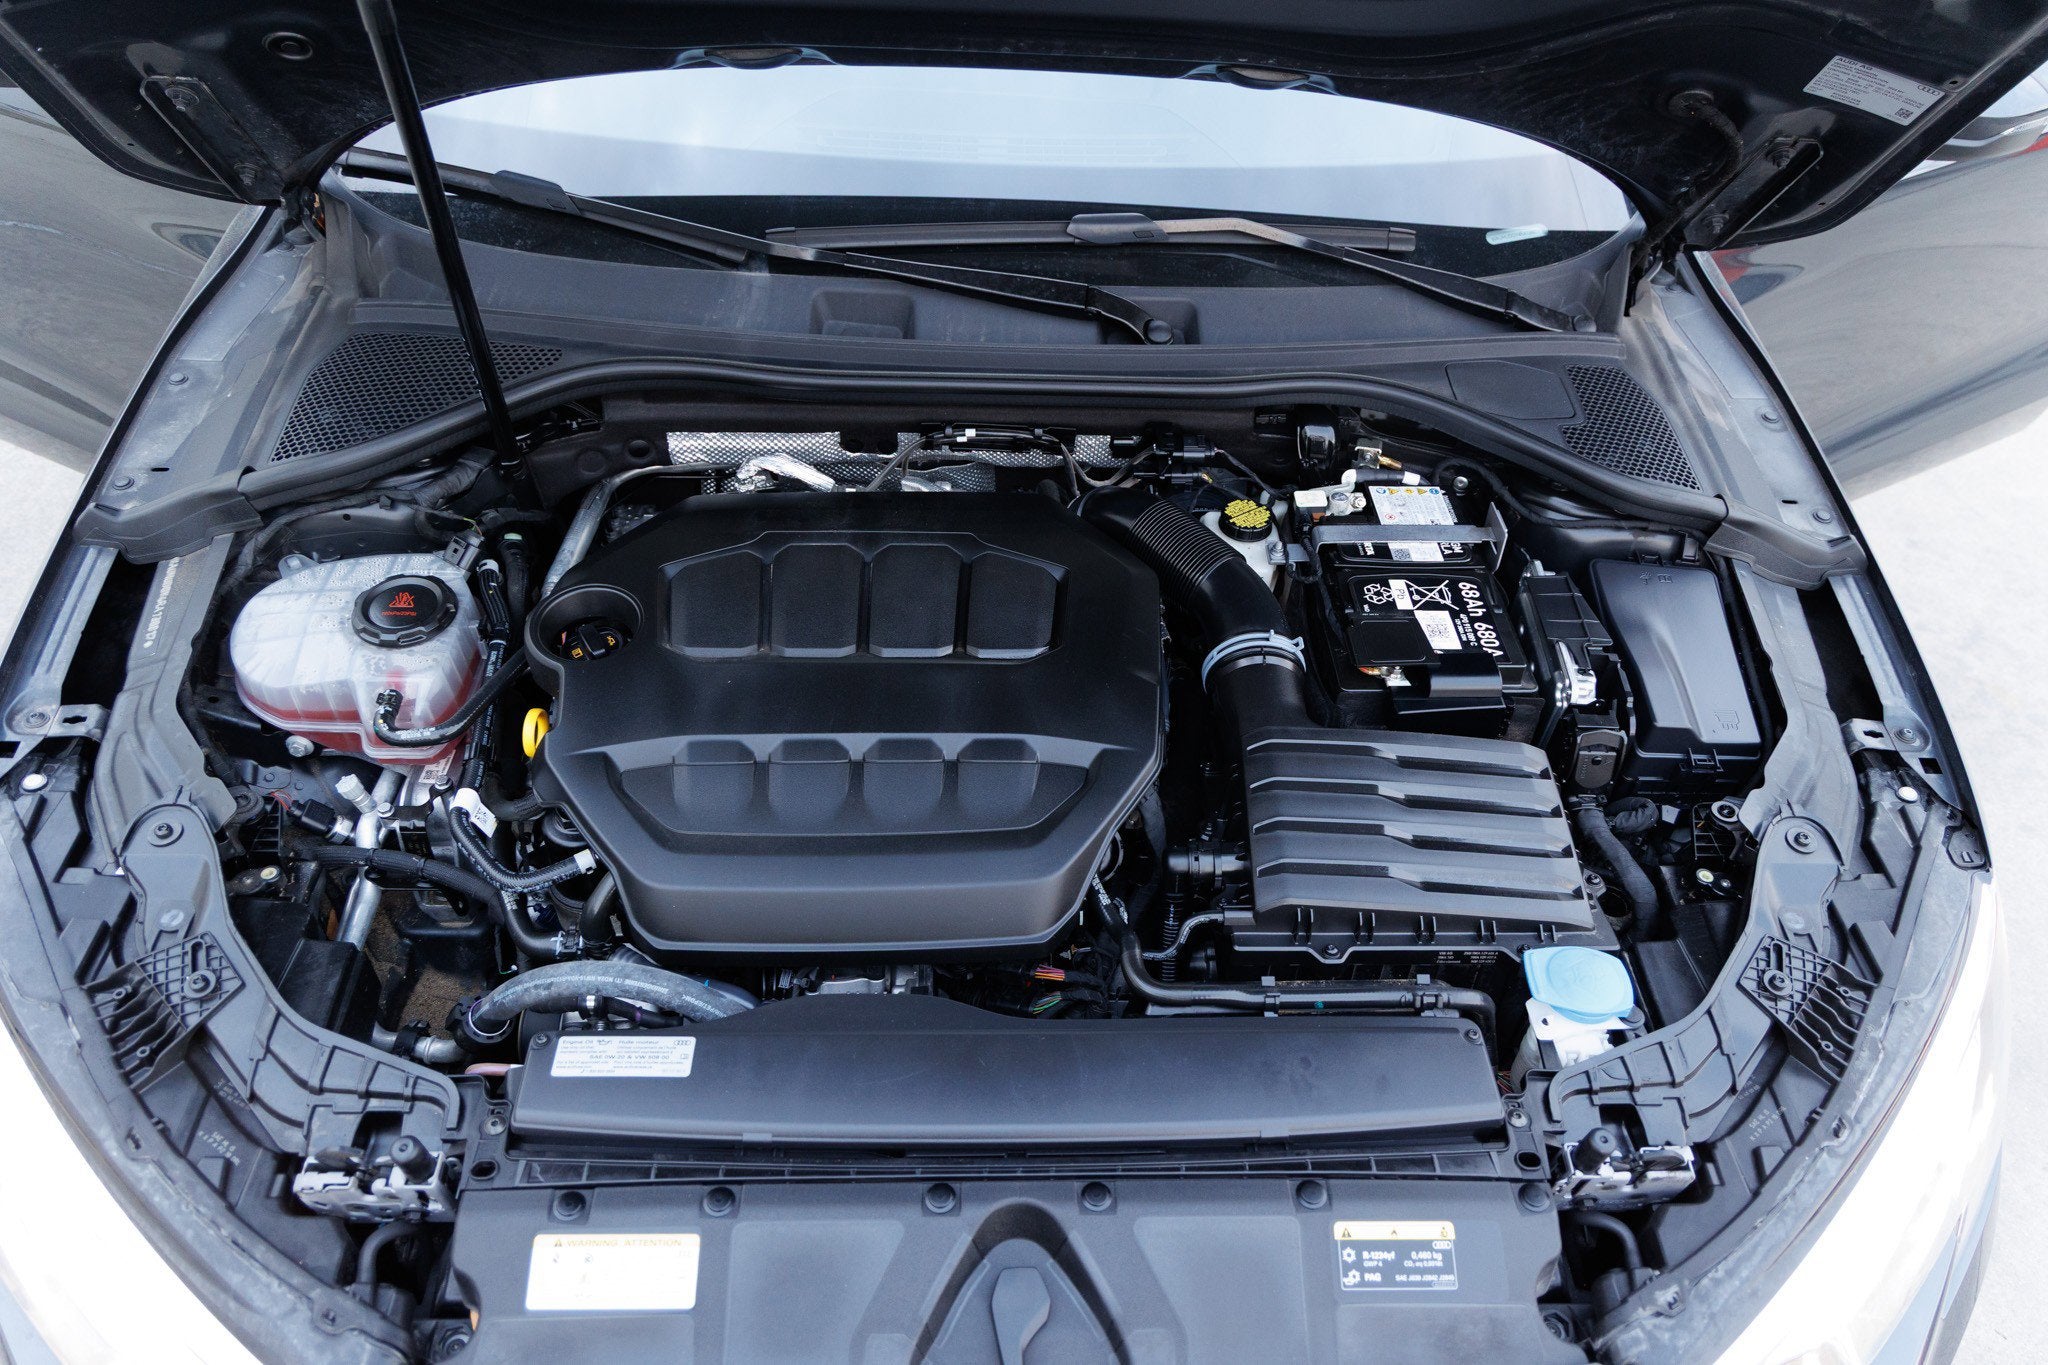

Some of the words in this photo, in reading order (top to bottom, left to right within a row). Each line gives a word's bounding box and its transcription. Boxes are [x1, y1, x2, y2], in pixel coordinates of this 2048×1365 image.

[1836, 56, 1858, 66] AUDI
[1458, 581, 1487, 617] 68Ah
[1474, 622, 1504, 657] 680A
[567, 1239, 618, 1247] WARNING
[624, 1239, 682, 1247] ATTENTION
